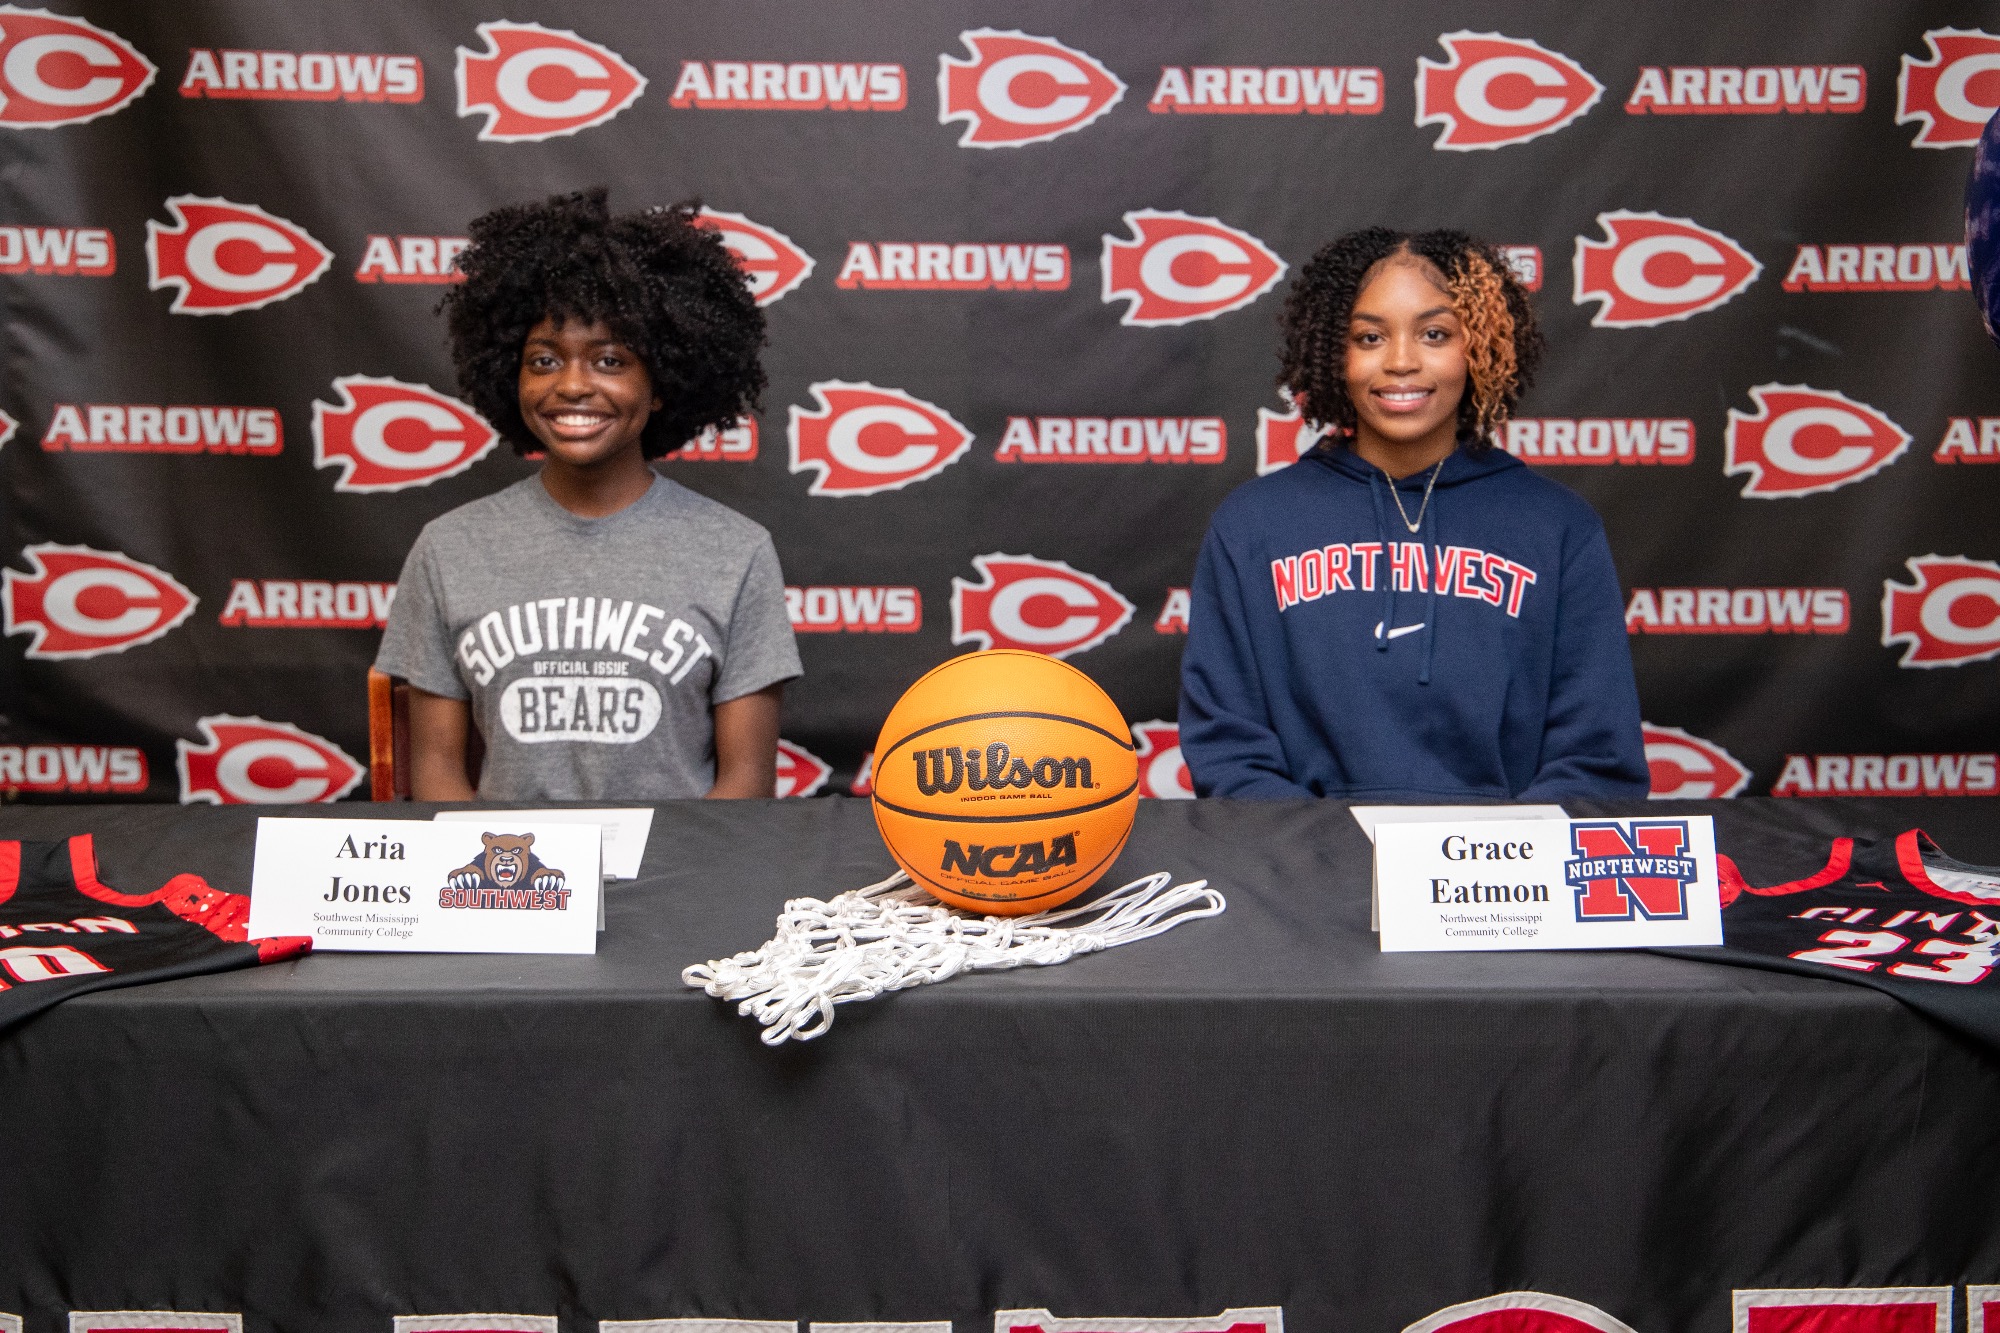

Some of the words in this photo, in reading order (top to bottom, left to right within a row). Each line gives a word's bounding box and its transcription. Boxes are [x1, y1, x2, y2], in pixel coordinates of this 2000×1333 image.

[182, 50, 420, 98] ARROWS
[672, 61, 903, 105] ARROWS
[1150, 67, 1380, 109] ARROWS
[1627, 66, 1862, 109] ARROWS
[838, 243, 1066, 285] ARROWS
[43, 404, 279, 449] ARROWS
[997, 417, 1223, 458] ARROWS
[1271, 542, 1537, 618] NORTHWEST
[1623, 588, 1846, 629] ARROWS
[458, 597, 712, 686] SOUTHWEST
[533, 661, 589, 676] OFFICIAL
[594, 661, 629, 676] ISSUE
[518, 685, 645, 734] BEARS
[913, 741, 1093, 796] Wilson
[1774, 753, 1998, 794] ARROWS
[960, 795, 996, 803] INDOOR
[336, 833, 405, 861] Aria
[940, 832, 1078, 878] NCAA
[1441, 835, 1534, 861] Grace
[940, 872, 997, 886] OFFICIAL
[1000, 877, 1040, 886] GAME
[1043, 869, 1076, 881] BALL
[1567, 857, 1694, 880] NORTHWEST
[323, 876, 412, 905] Jones
[438, 886, 572, 910] SOUTHWEST
[1429, 878, 1550, 904] Eatmon
[313, 912, 363, 922] Southwest
[365, 913, 419, 926] Mississippi
[317, 926, 374, 939] Community
[376, 927, 413, 940] College
[1440, 913, 1488, 923] Northwest
[1490, 912, 1543, 925] Mississippi
[1445, 927, 1500, 939] Community
[1502, 926, 1539, 938] College
[1787, 928, 1994, 985] 23
